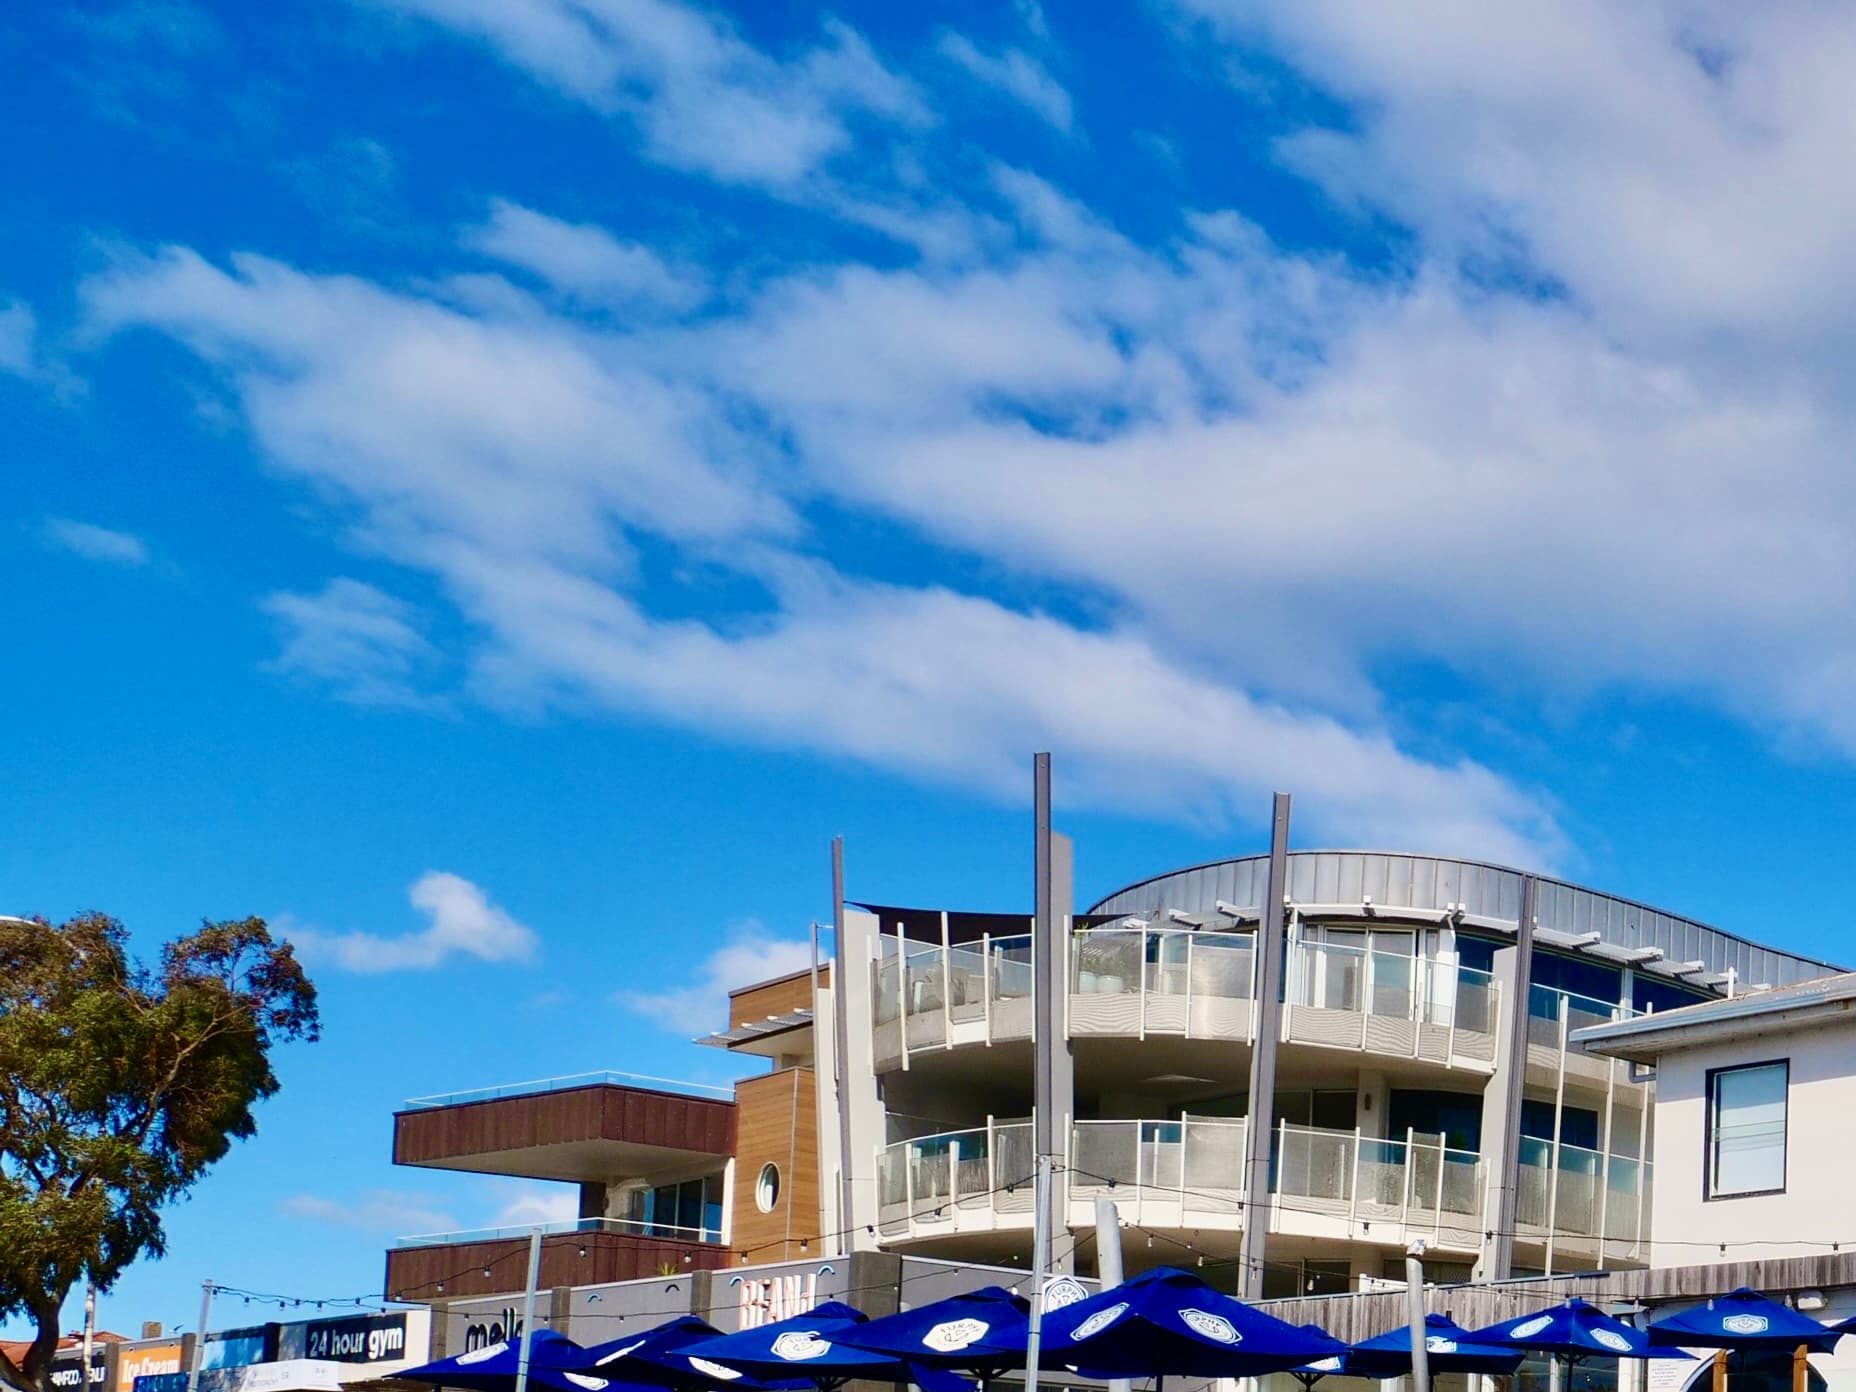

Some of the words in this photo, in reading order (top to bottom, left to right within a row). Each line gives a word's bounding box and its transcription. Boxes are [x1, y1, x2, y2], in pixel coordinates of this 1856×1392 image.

[309, 1330, 327, 1358] 24
[332, 1329, 366, 1357] hour
[367, 1327, 403, 1360] gym
[122, 1359, 140, 1384] Ice
[142, 1356, 180, 1378] Cream
